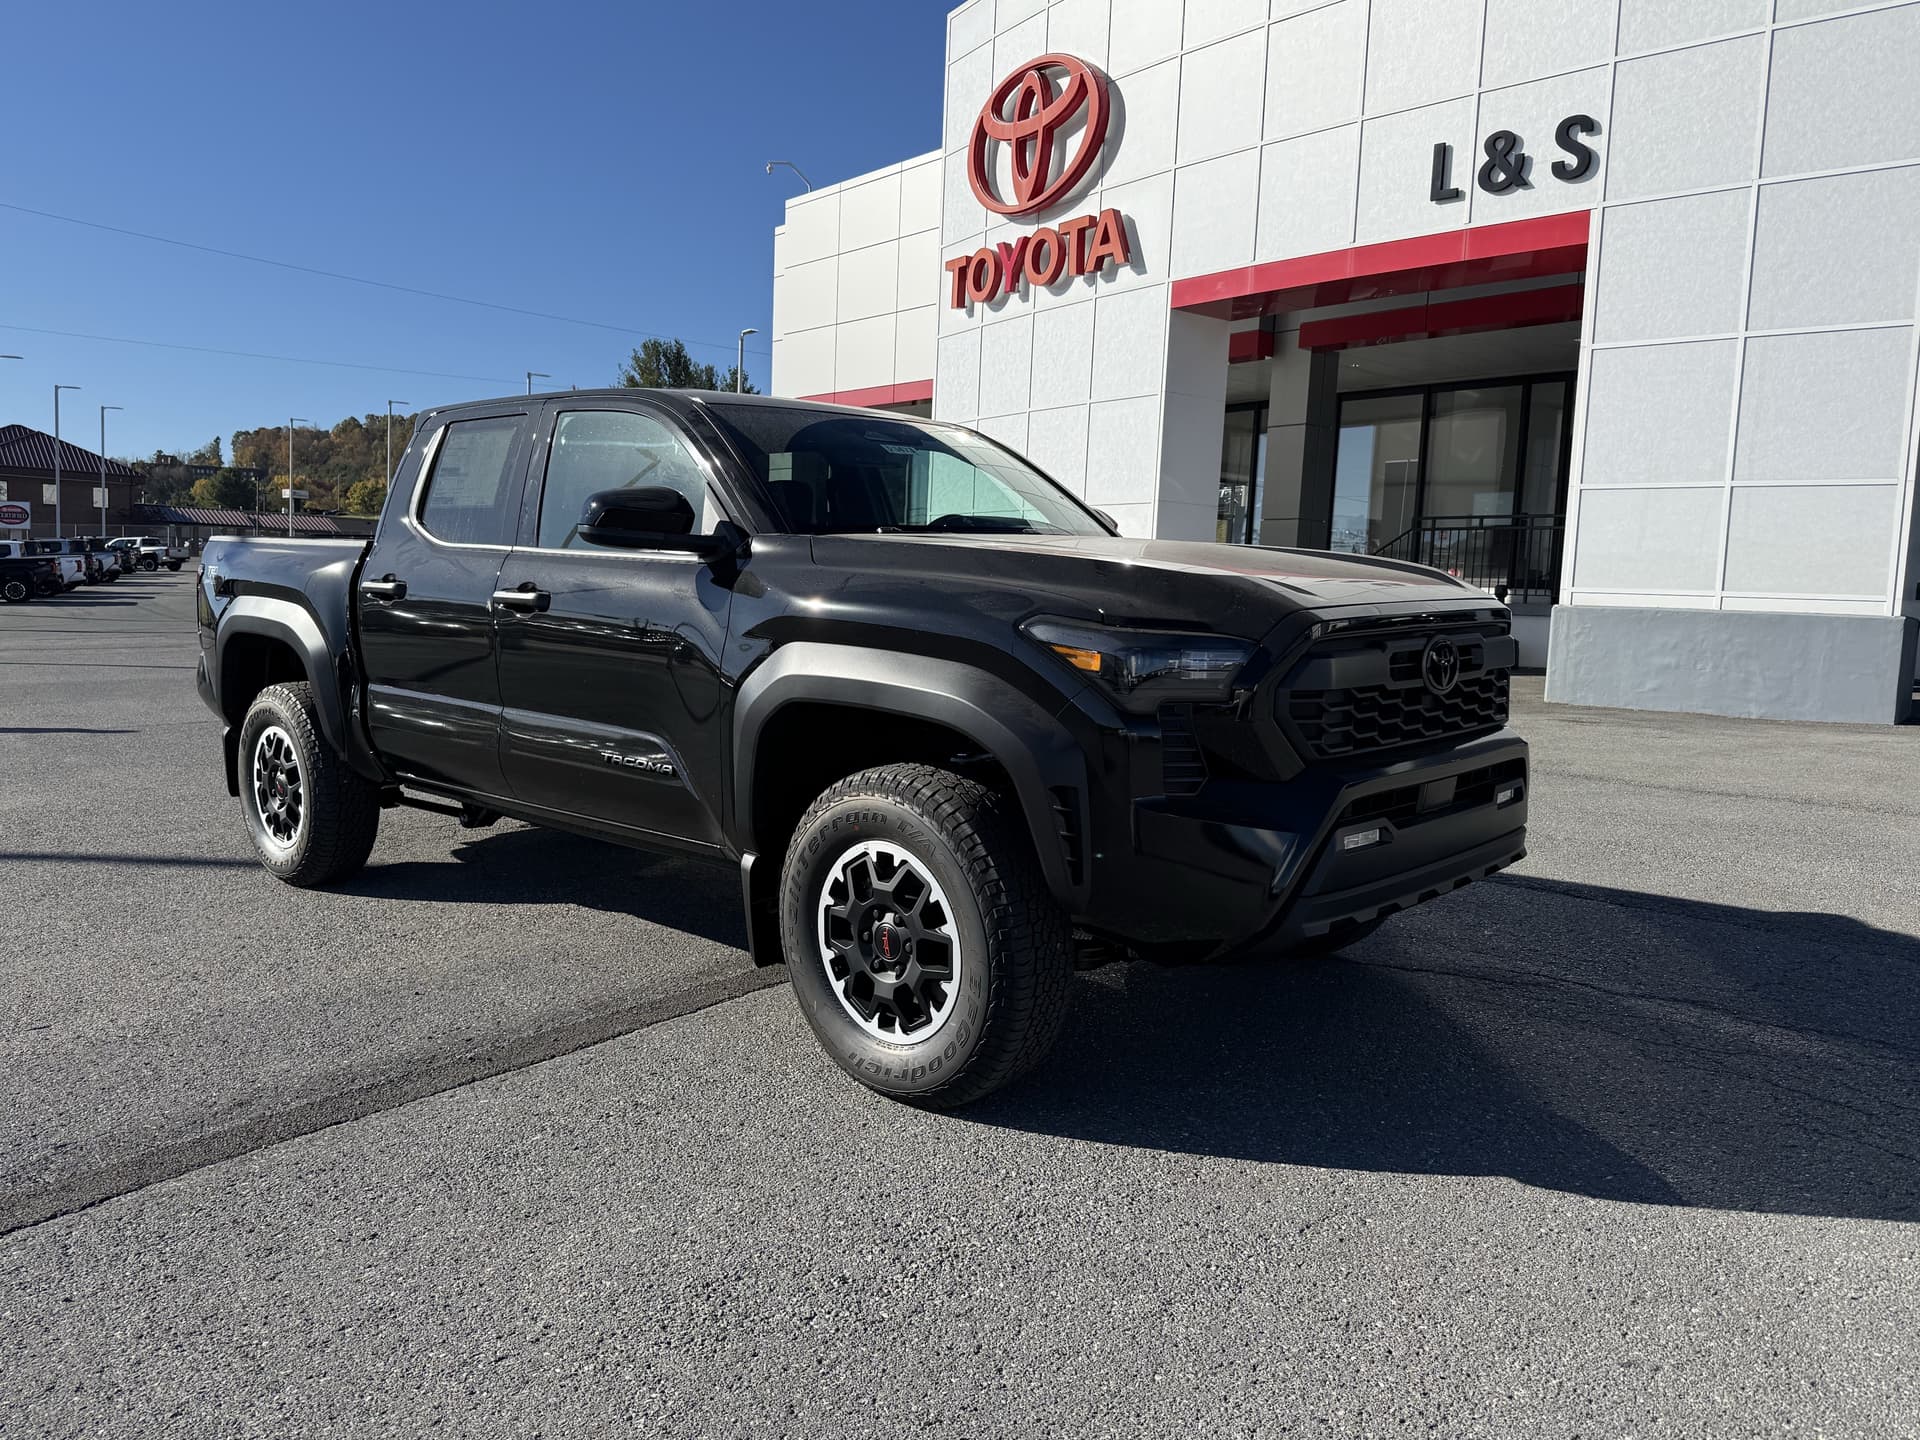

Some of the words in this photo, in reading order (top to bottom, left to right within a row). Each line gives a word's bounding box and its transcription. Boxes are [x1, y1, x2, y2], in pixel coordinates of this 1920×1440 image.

[1430, 142, 1459, 202] L
[1477, 130, 1529, 193] &
[1551, 114, 1595, 180] S
[945, 208, 1131, 309] TOYOTA
[600, 752, 673, 775] TACOMA
